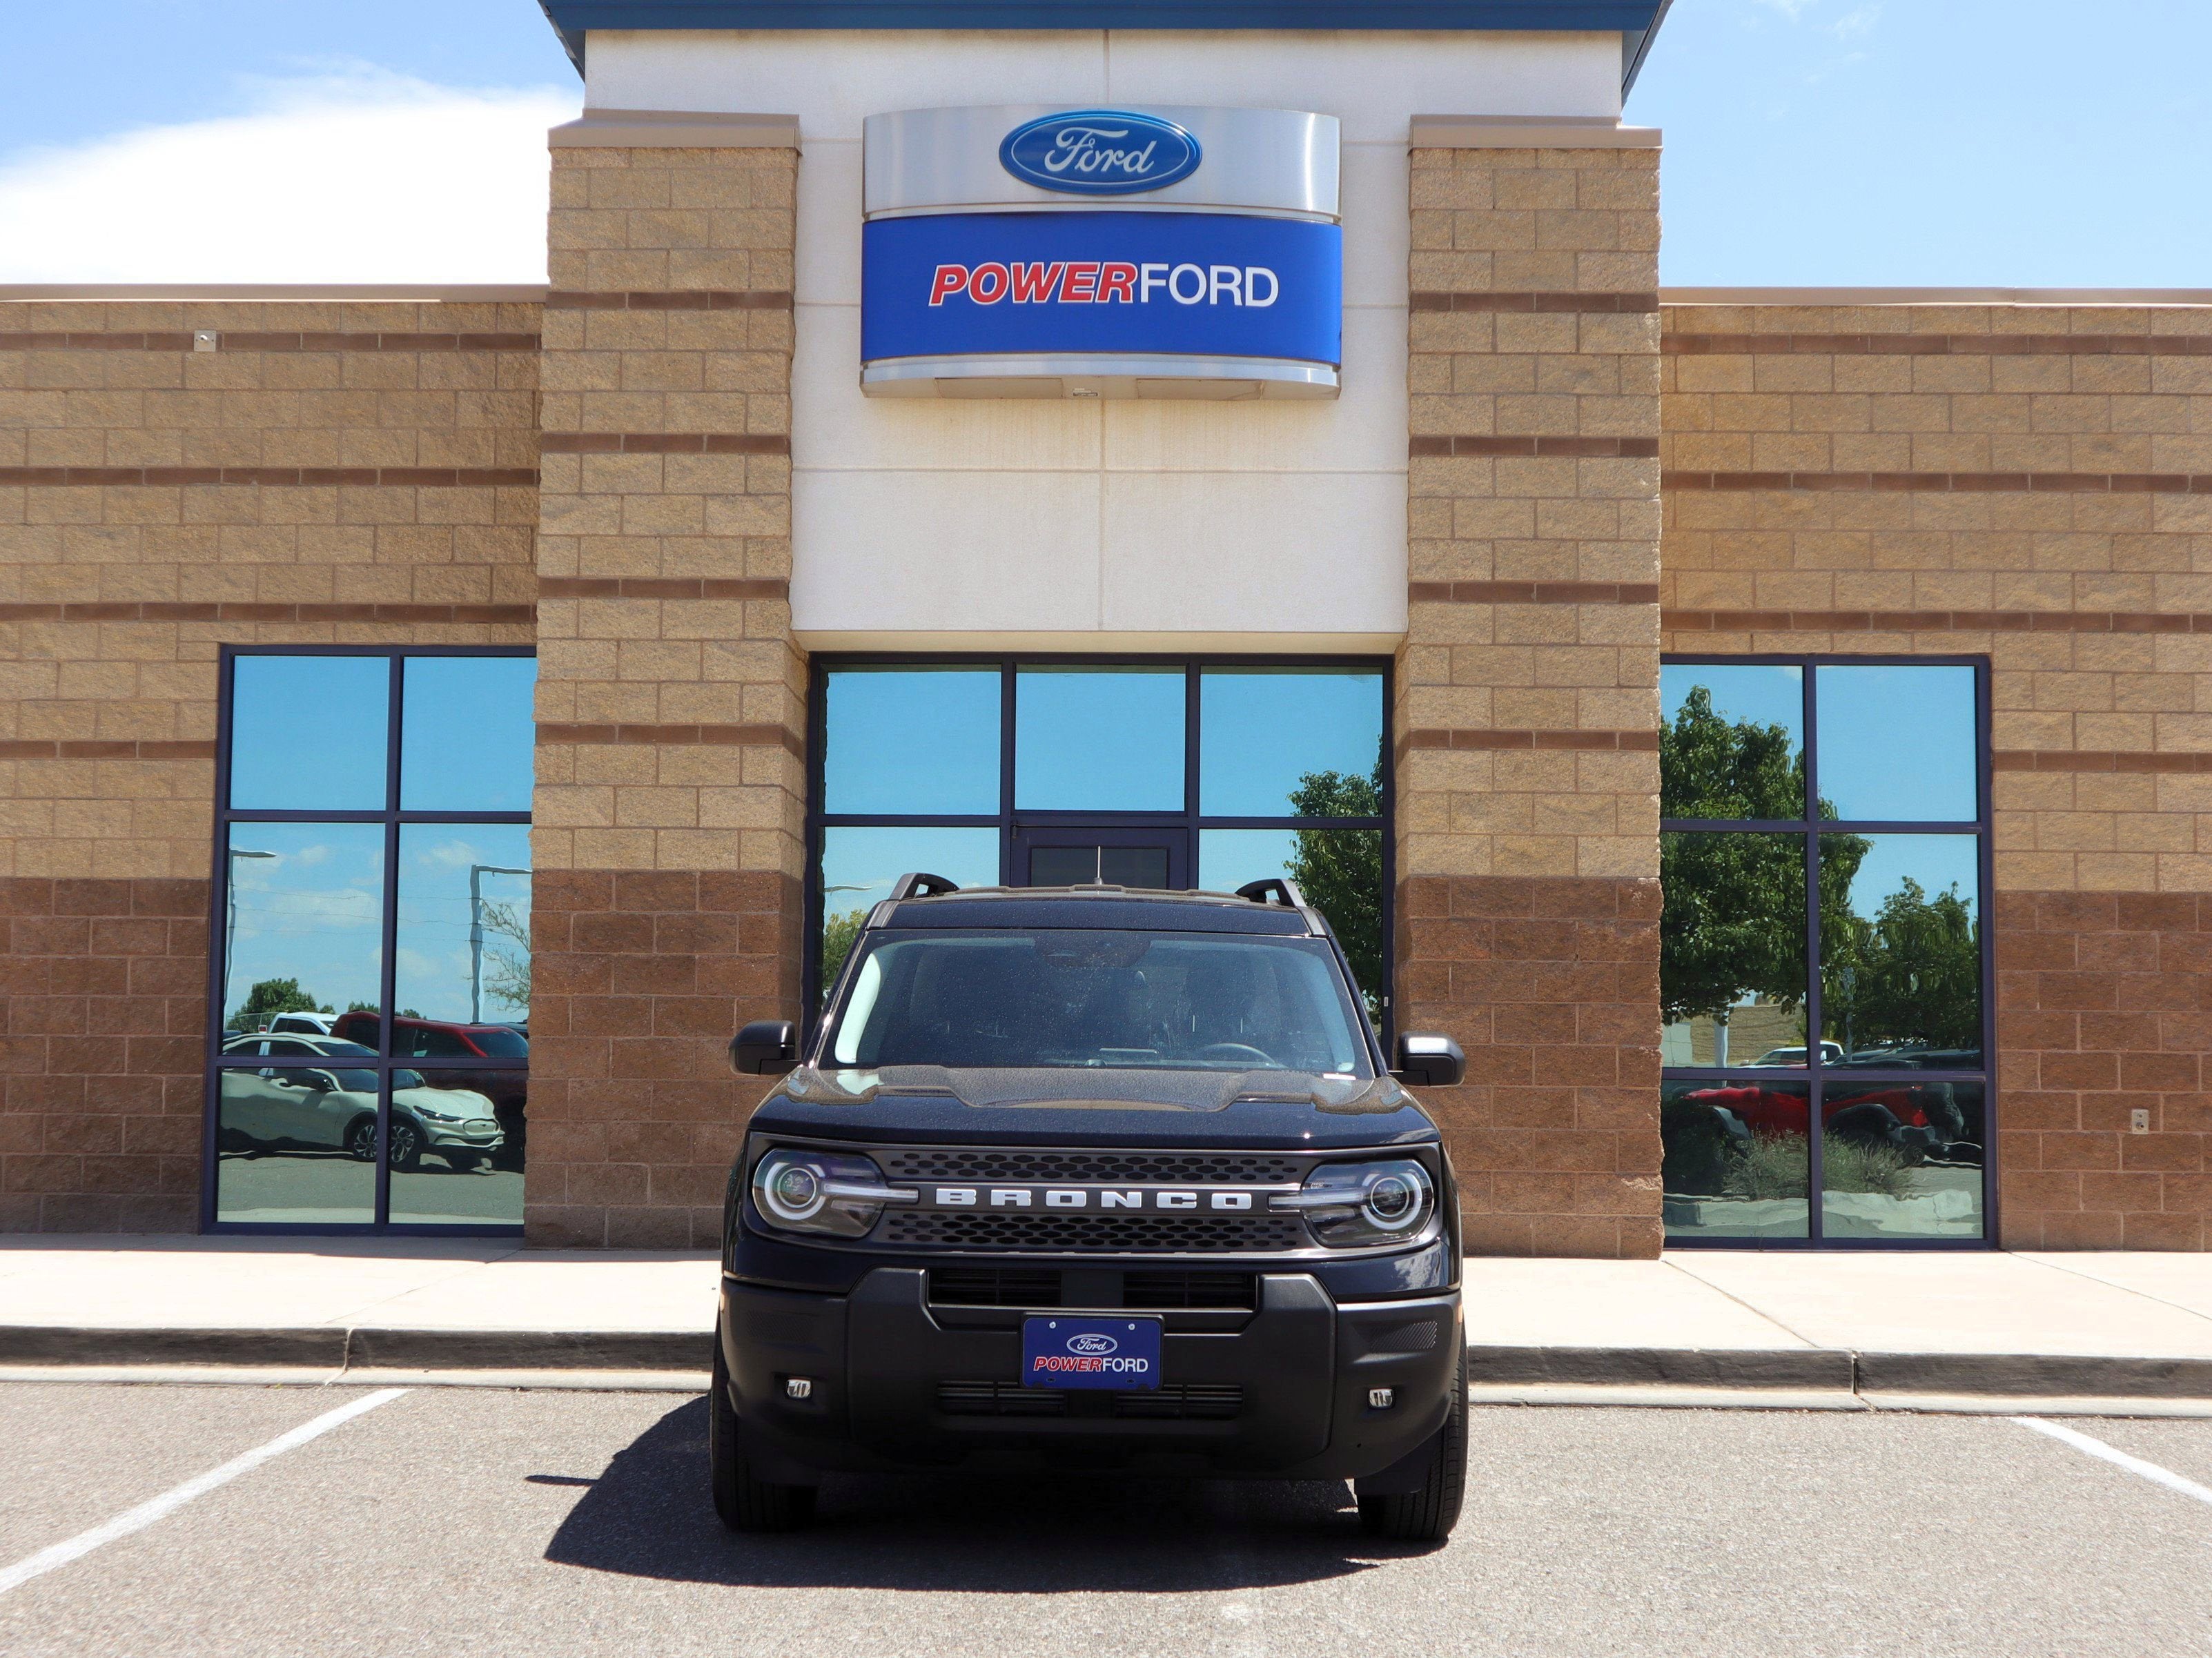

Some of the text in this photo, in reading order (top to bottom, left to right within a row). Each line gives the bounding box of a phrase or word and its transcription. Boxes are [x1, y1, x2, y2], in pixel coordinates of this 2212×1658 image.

[1044, 127, 1157, 173] Ford
[935, 1187, 1253, 1210] BRONCO
[1077, 1337, 1108, 1352] Ford
